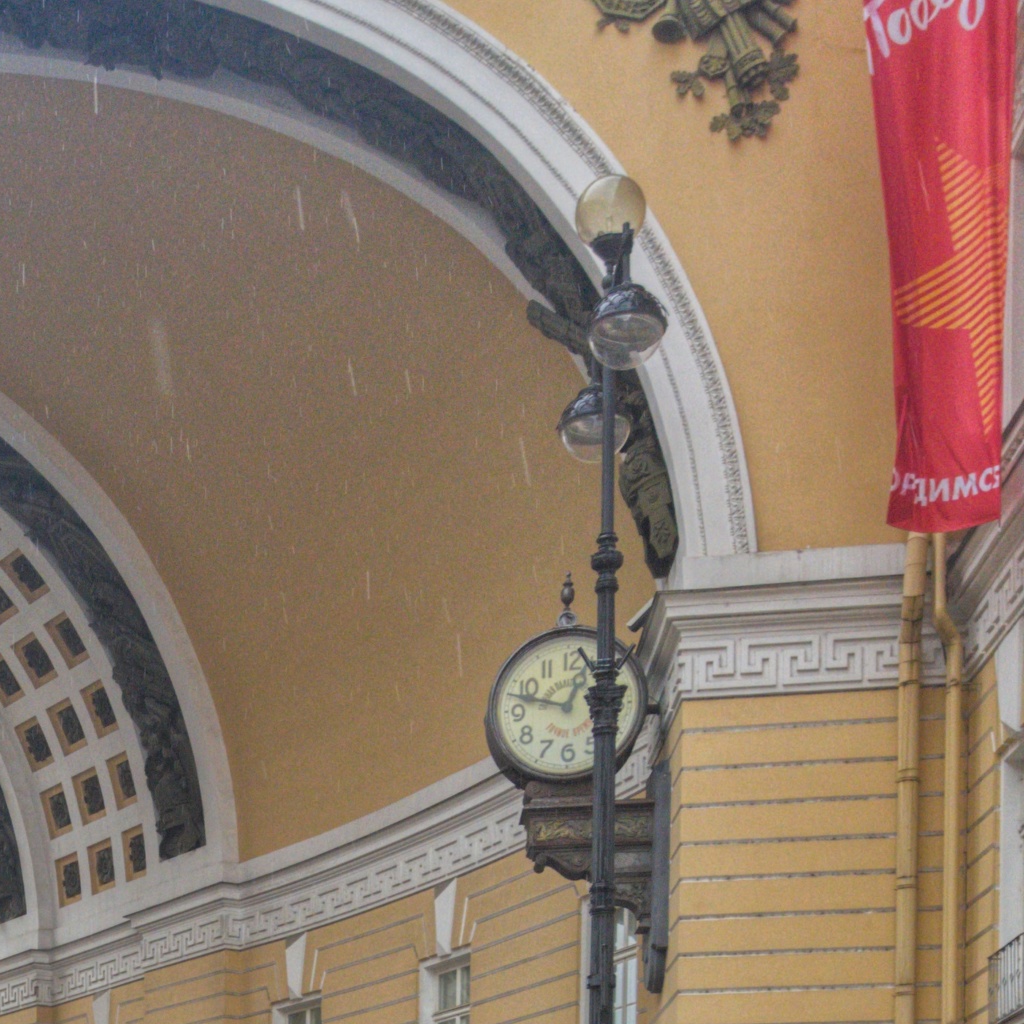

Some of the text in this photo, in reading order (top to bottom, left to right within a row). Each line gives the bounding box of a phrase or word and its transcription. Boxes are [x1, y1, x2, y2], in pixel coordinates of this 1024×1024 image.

[542, 659, 553, 679] 11
[563, 650, 583, 671] 12
[519, 677, 539, 699] 10
[511, 703, 526, 722] 9
[519, 725, 534, 745] 8
[539, 739, 554, 759] 7
[560, 743, 576, 763] 6
[584, 736, 595, 755] 5
